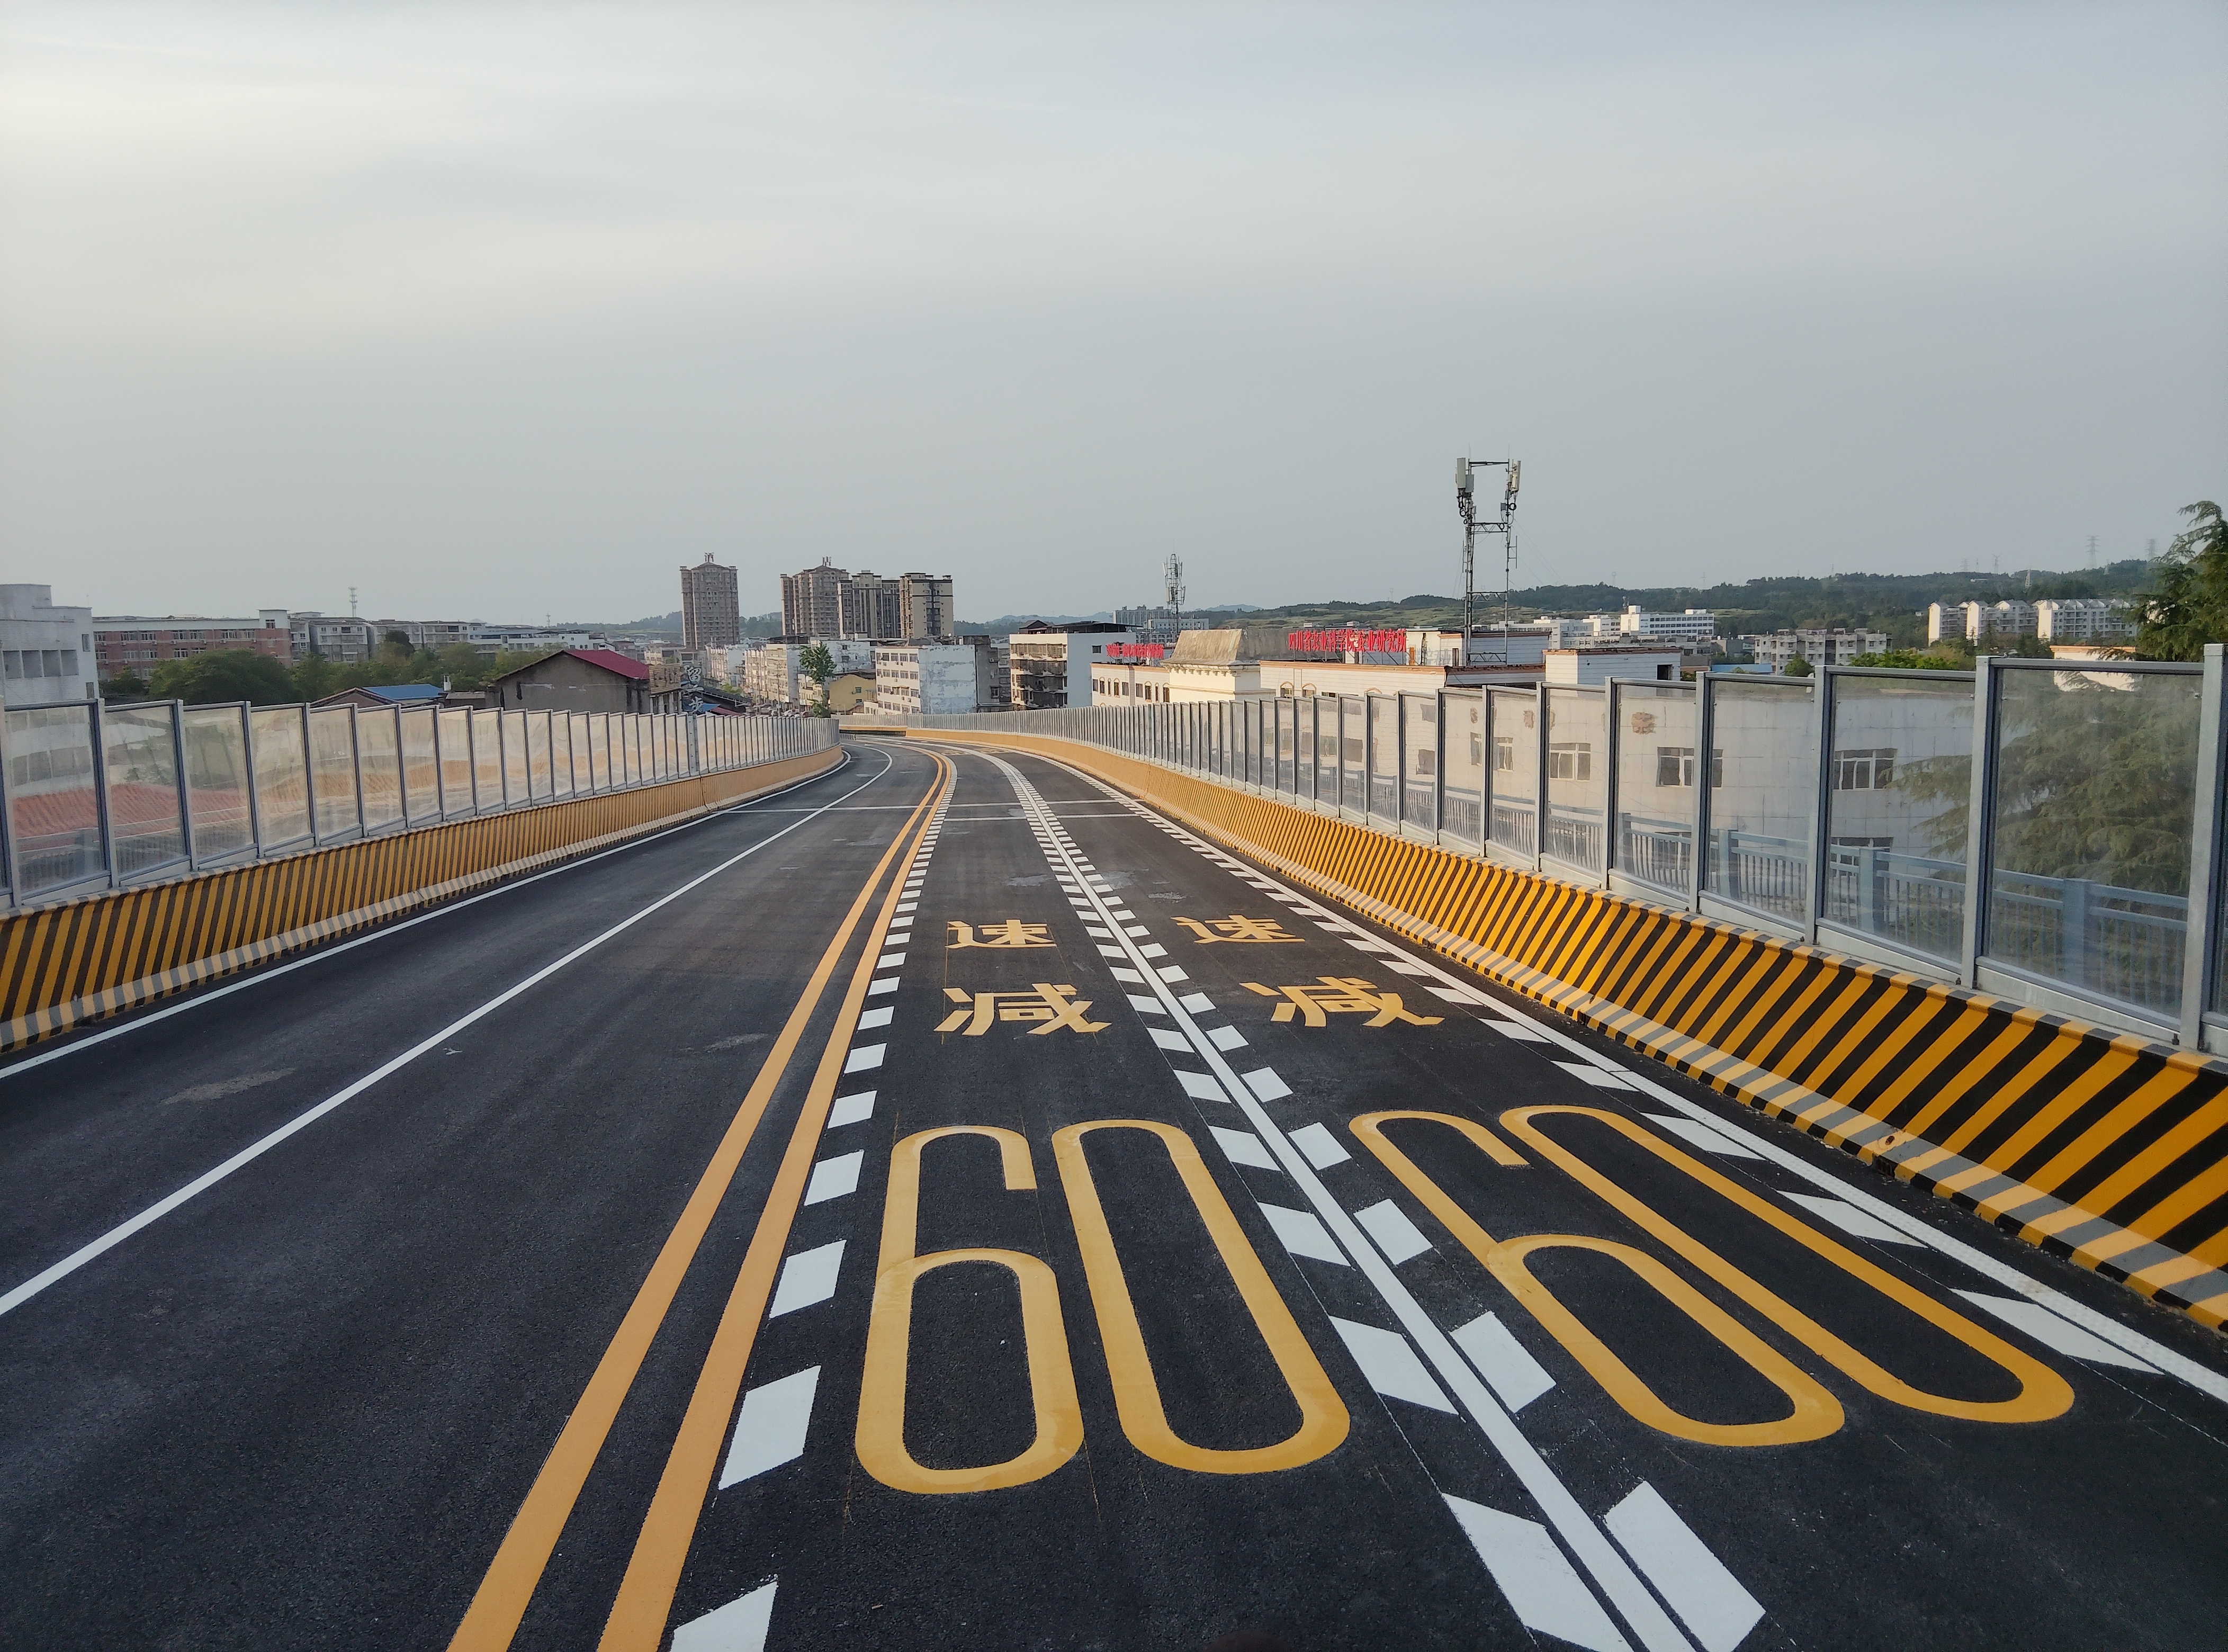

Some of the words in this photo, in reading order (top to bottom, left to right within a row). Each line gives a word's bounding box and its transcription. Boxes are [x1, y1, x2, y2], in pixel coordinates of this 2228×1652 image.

[946, 919, 1057, 948] 速
[1171, 914, 1305, 944] 速
[934, 983, 1112, 1036] 减
[1239, 976, 1445, 1028] 减
[1349, 1106, 2074, 1447] 60
[856, 1119, 1350, 1494] 60
